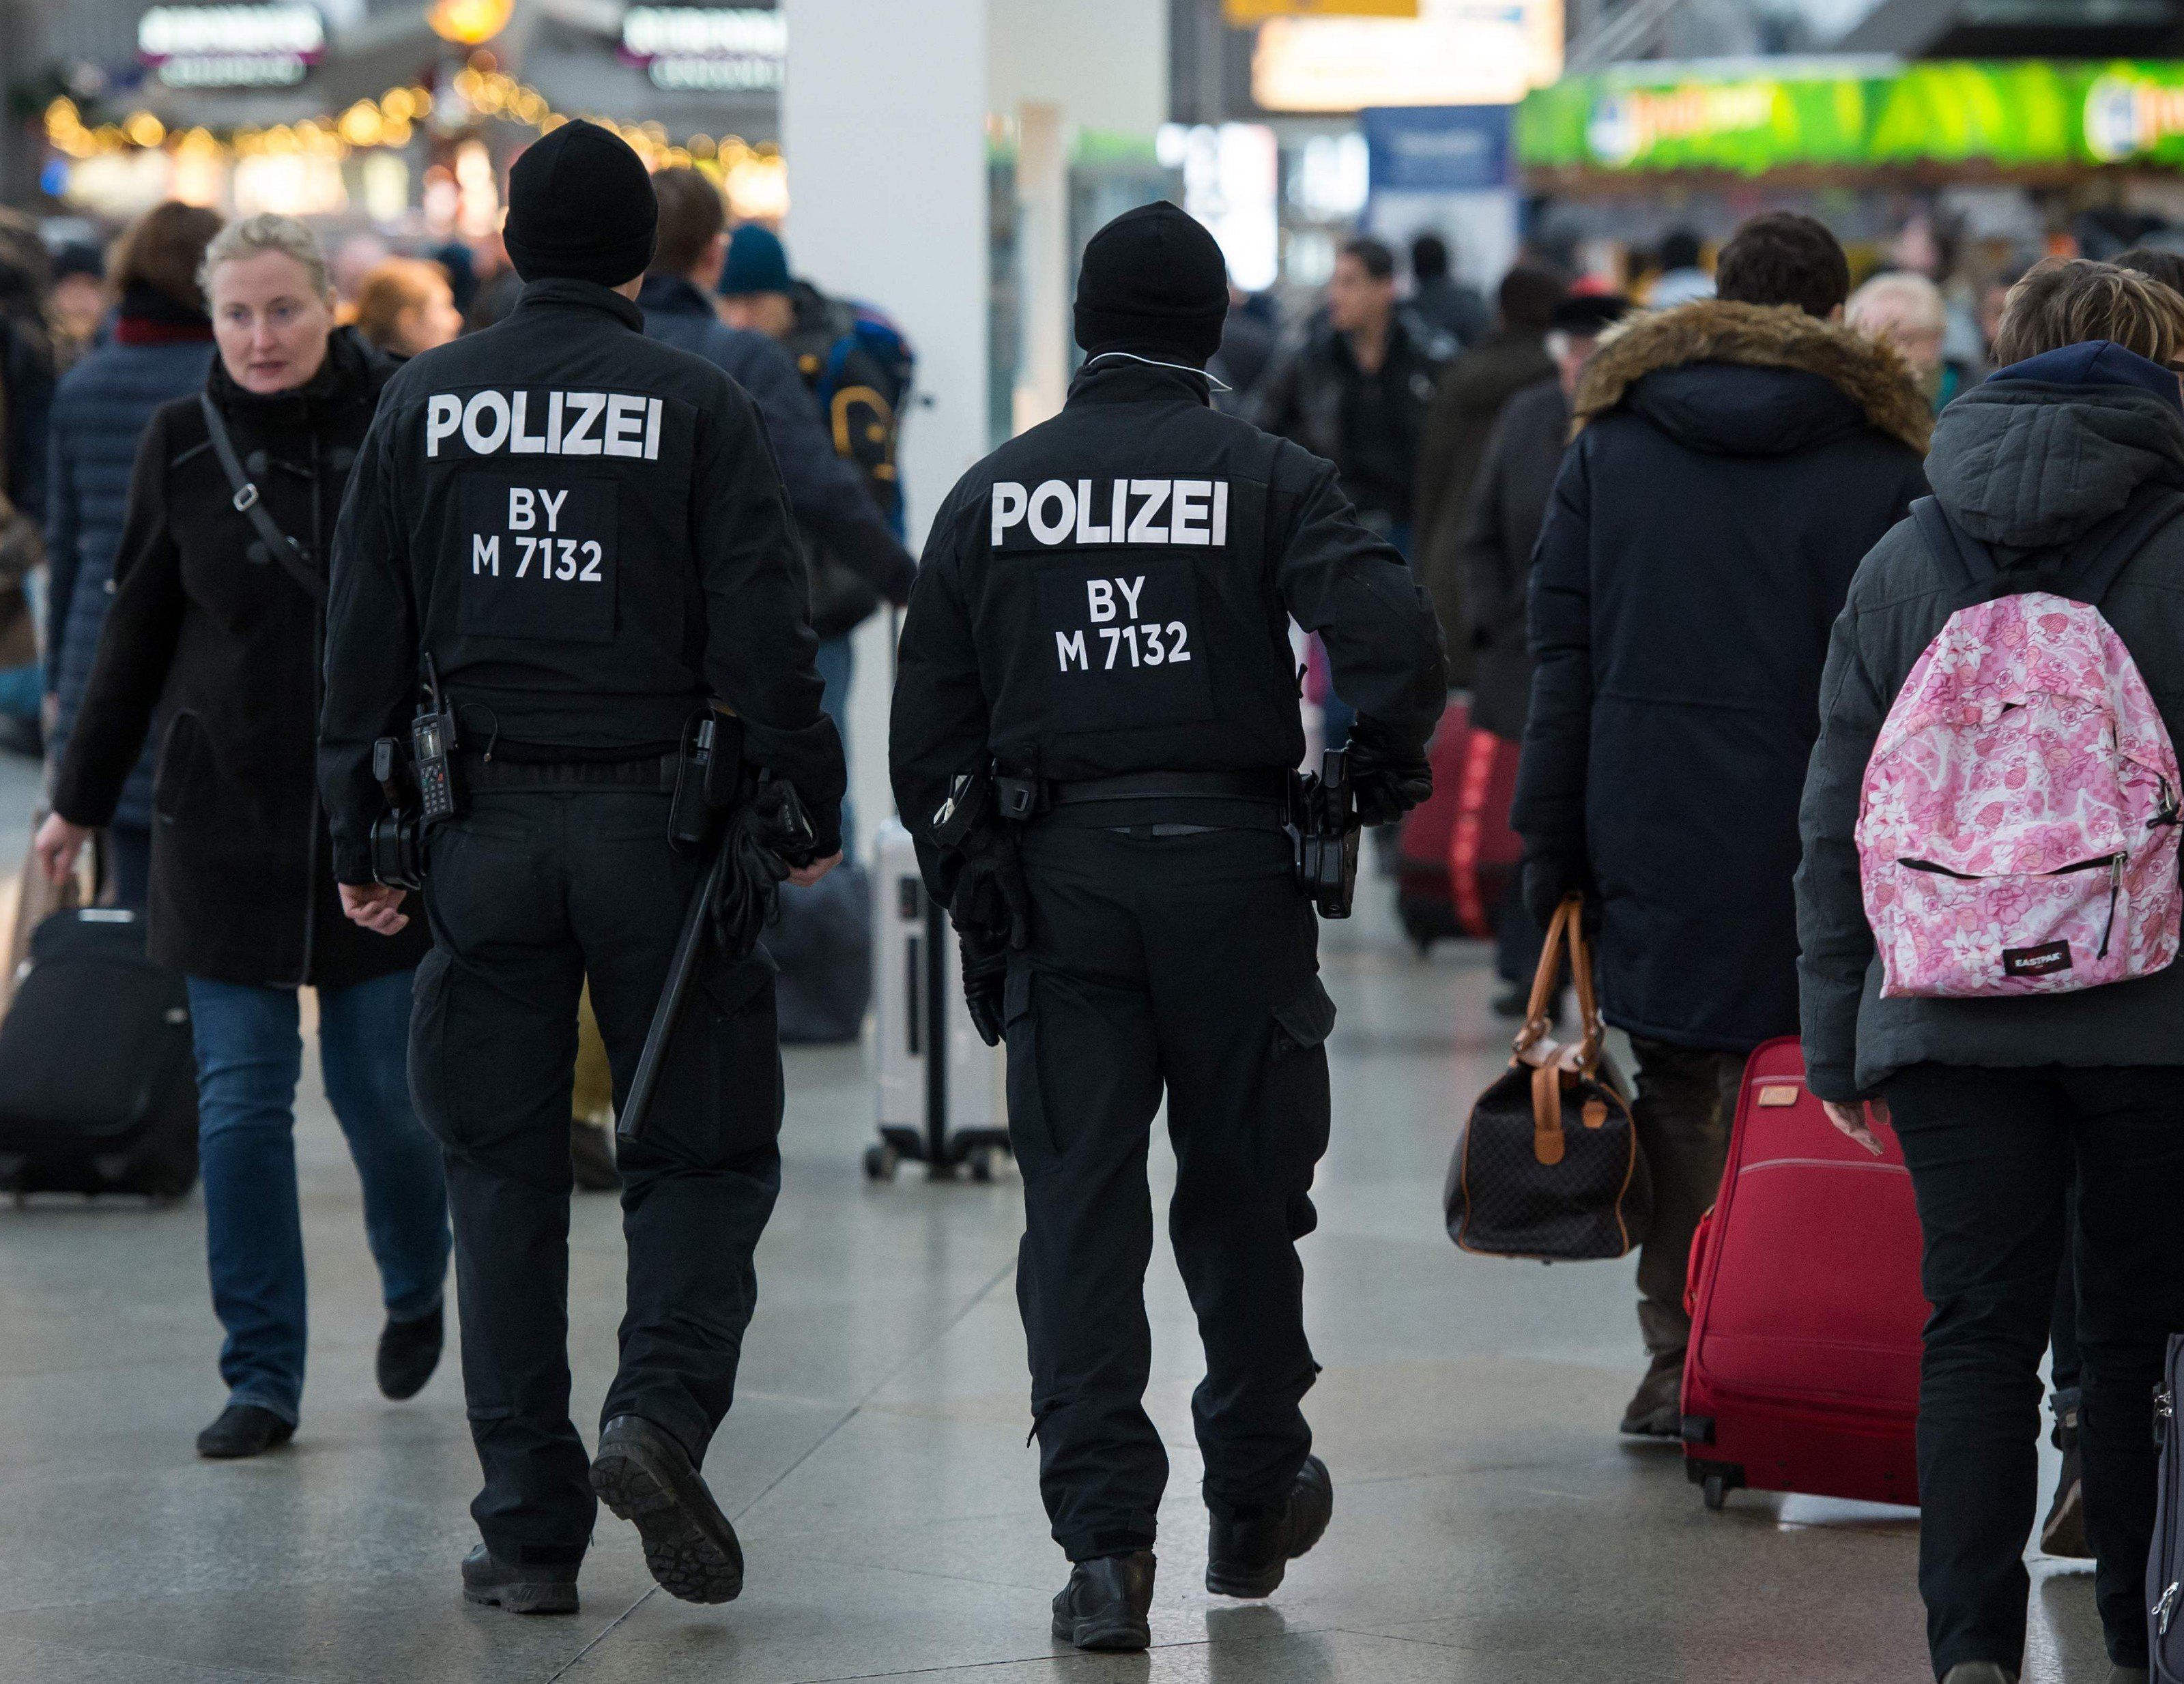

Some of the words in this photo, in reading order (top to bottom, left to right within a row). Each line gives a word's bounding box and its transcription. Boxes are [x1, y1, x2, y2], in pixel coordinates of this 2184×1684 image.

[427, 390, 663, 461] POLIZEI
[508, 487, 569, 532] BY
[992, 479, 1228, 546] POLIZEI
[473, 534, 500, 577] M
[515, 536, 602, 582] 7132
[1087, 575, 1146, 623] BY
[1055, 630, 1089, 672] M
[1099, 621, 1191, 670] 7132
[2015, 952, 2062, 967] EASTPAK
